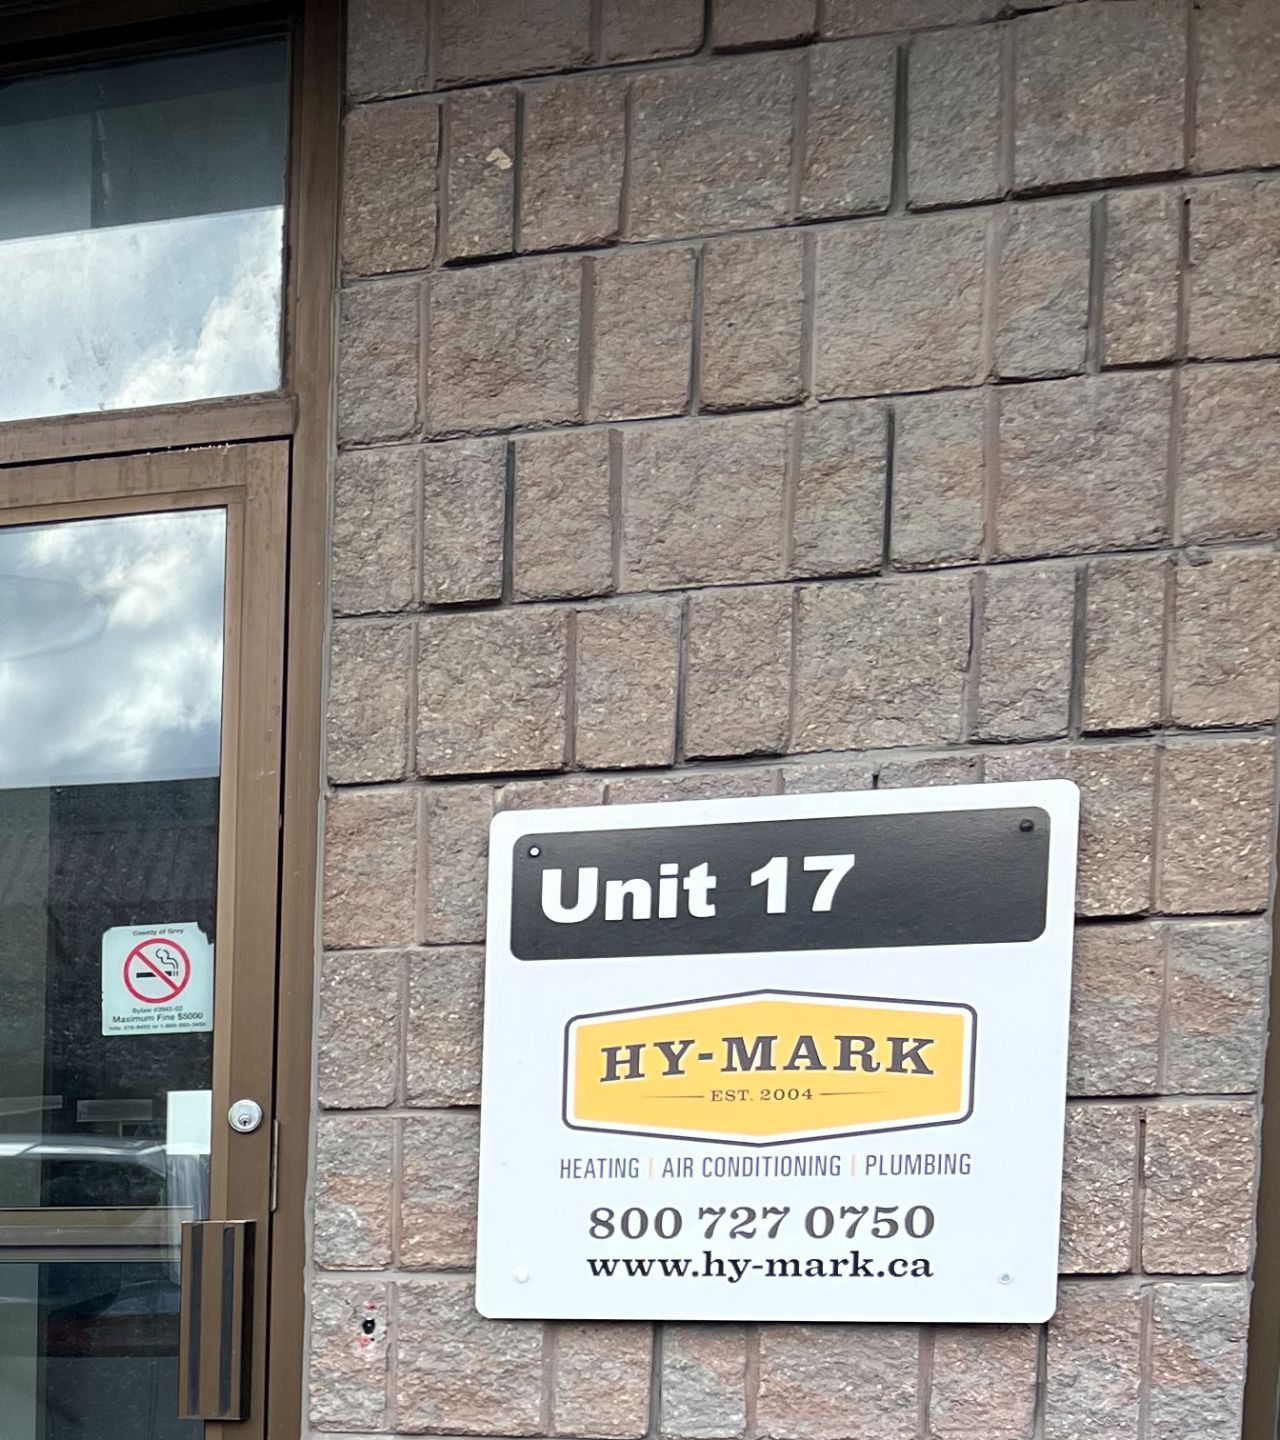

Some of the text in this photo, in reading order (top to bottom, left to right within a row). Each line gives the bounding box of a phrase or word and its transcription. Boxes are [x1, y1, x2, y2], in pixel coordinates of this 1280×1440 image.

[540, 853, 856, 924] Unit 17
[112, 1015, 155, 1023] Maximum
[599, 1034, 935, 1083] HY-MARK
[710, 1088, 814, 1103] EST. 2004
[560, 1153, 972, 1179] HEATING AIR CONDITIONING PLUMBING
[588, 1205, 936, 1240] 800 727 0750
[586, 1250, 935, 1284] www.hy-mark.ca
